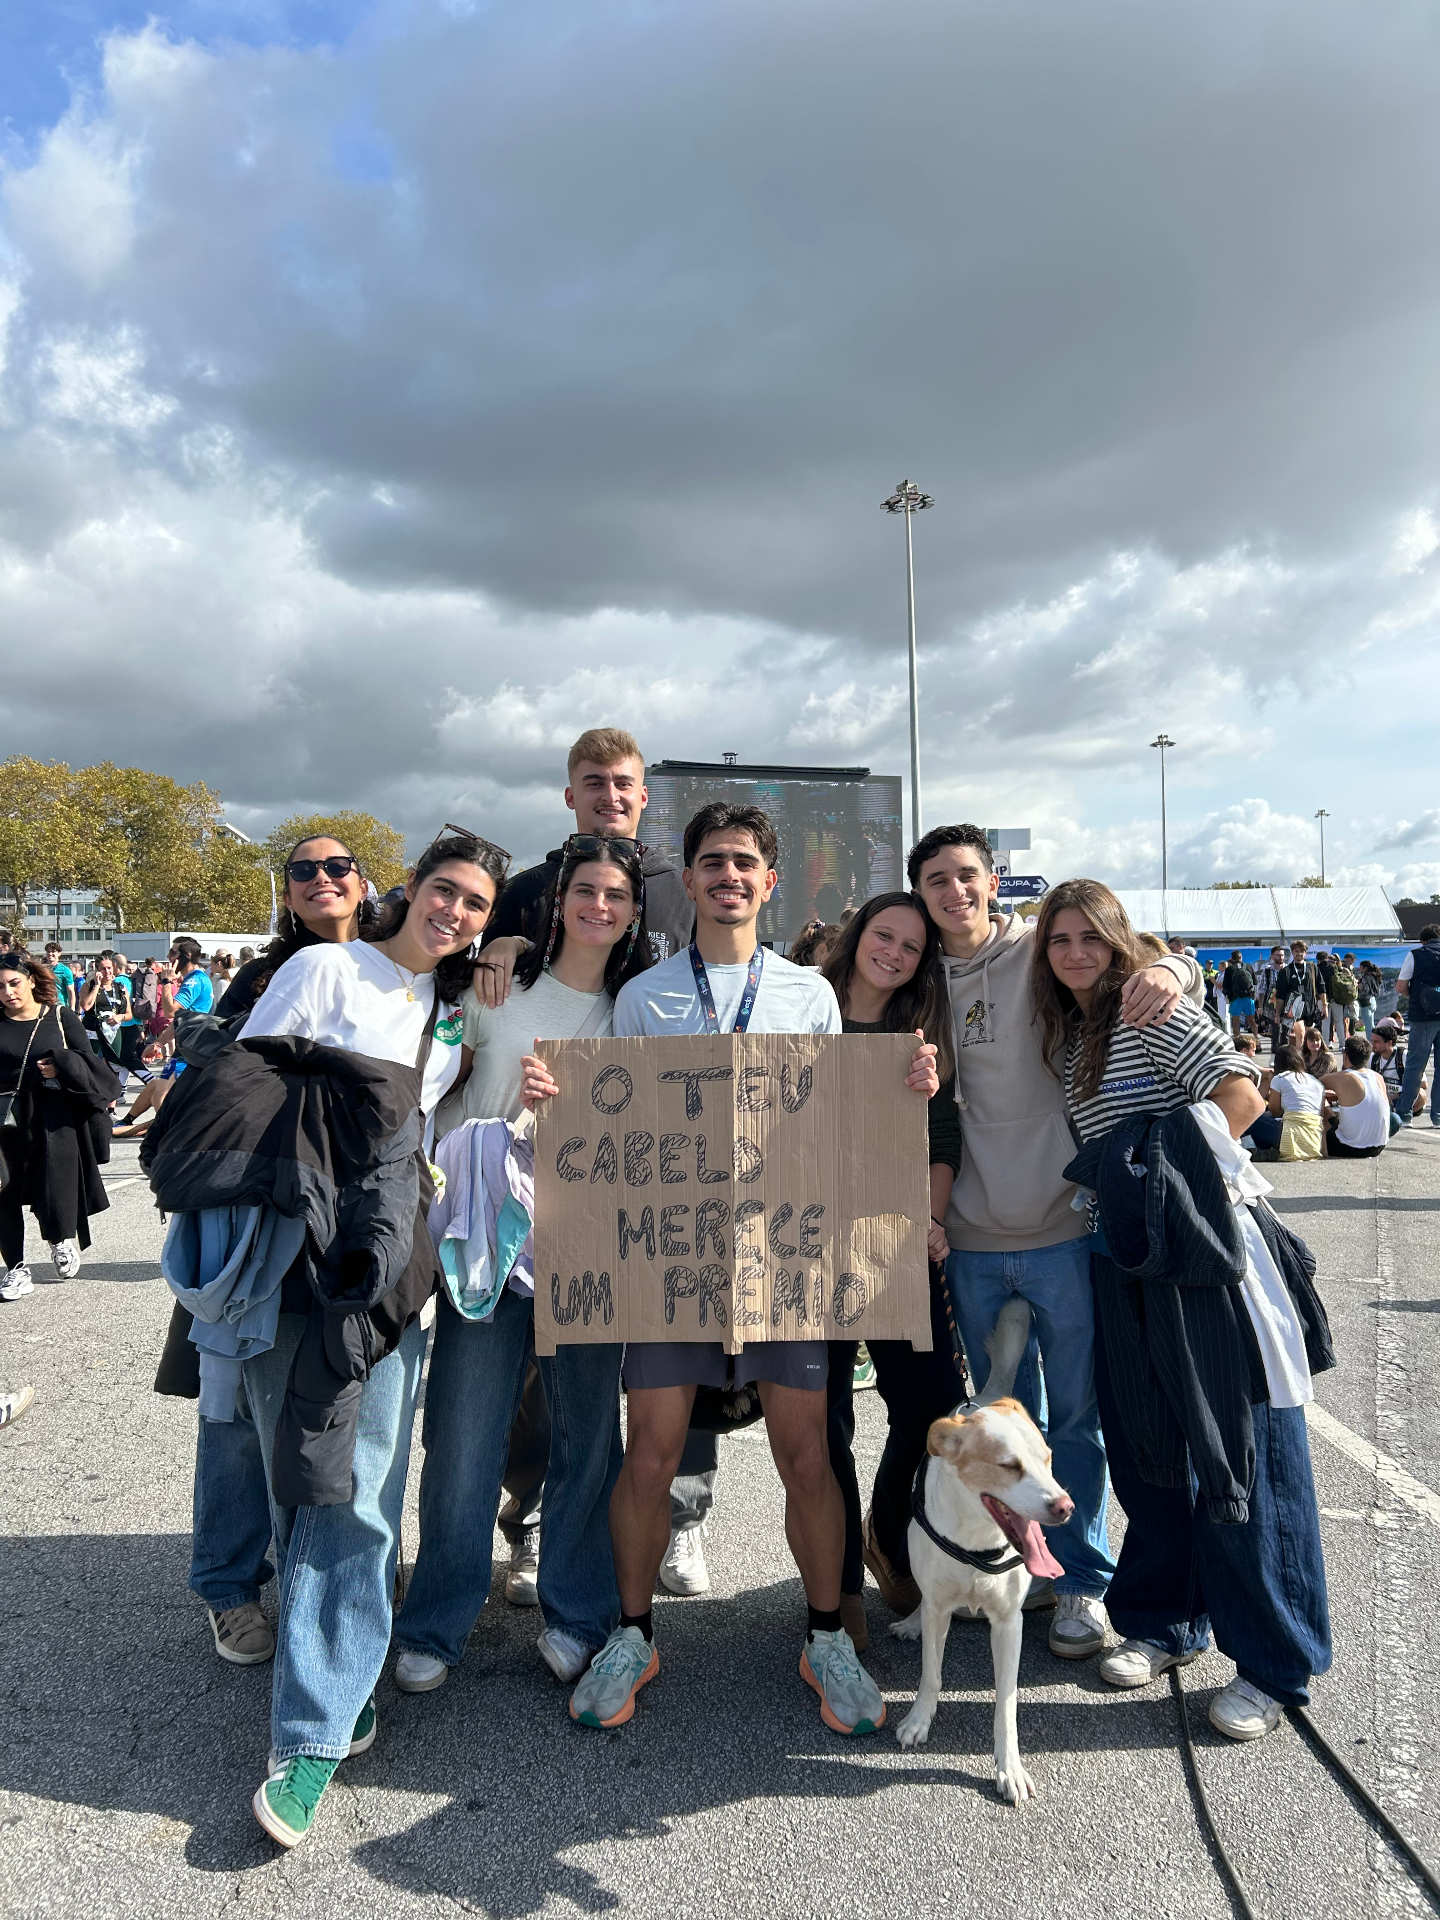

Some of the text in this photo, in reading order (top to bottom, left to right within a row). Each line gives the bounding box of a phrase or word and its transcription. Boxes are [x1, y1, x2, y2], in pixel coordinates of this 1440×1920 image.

[647, 930, 666, 940] KIES
[437, 1020, 463, 1037] Smile
[591, 1063, 633, 1115] O
[1118, 1080, 1133, 1092] ON
[1133, 1076, 1155, 1090] YOU
[556, 1131, 764, 1187] CABELO
[618, 1197, 826, 1260] MERECE
[551, 1270, 615, 1326] UM
